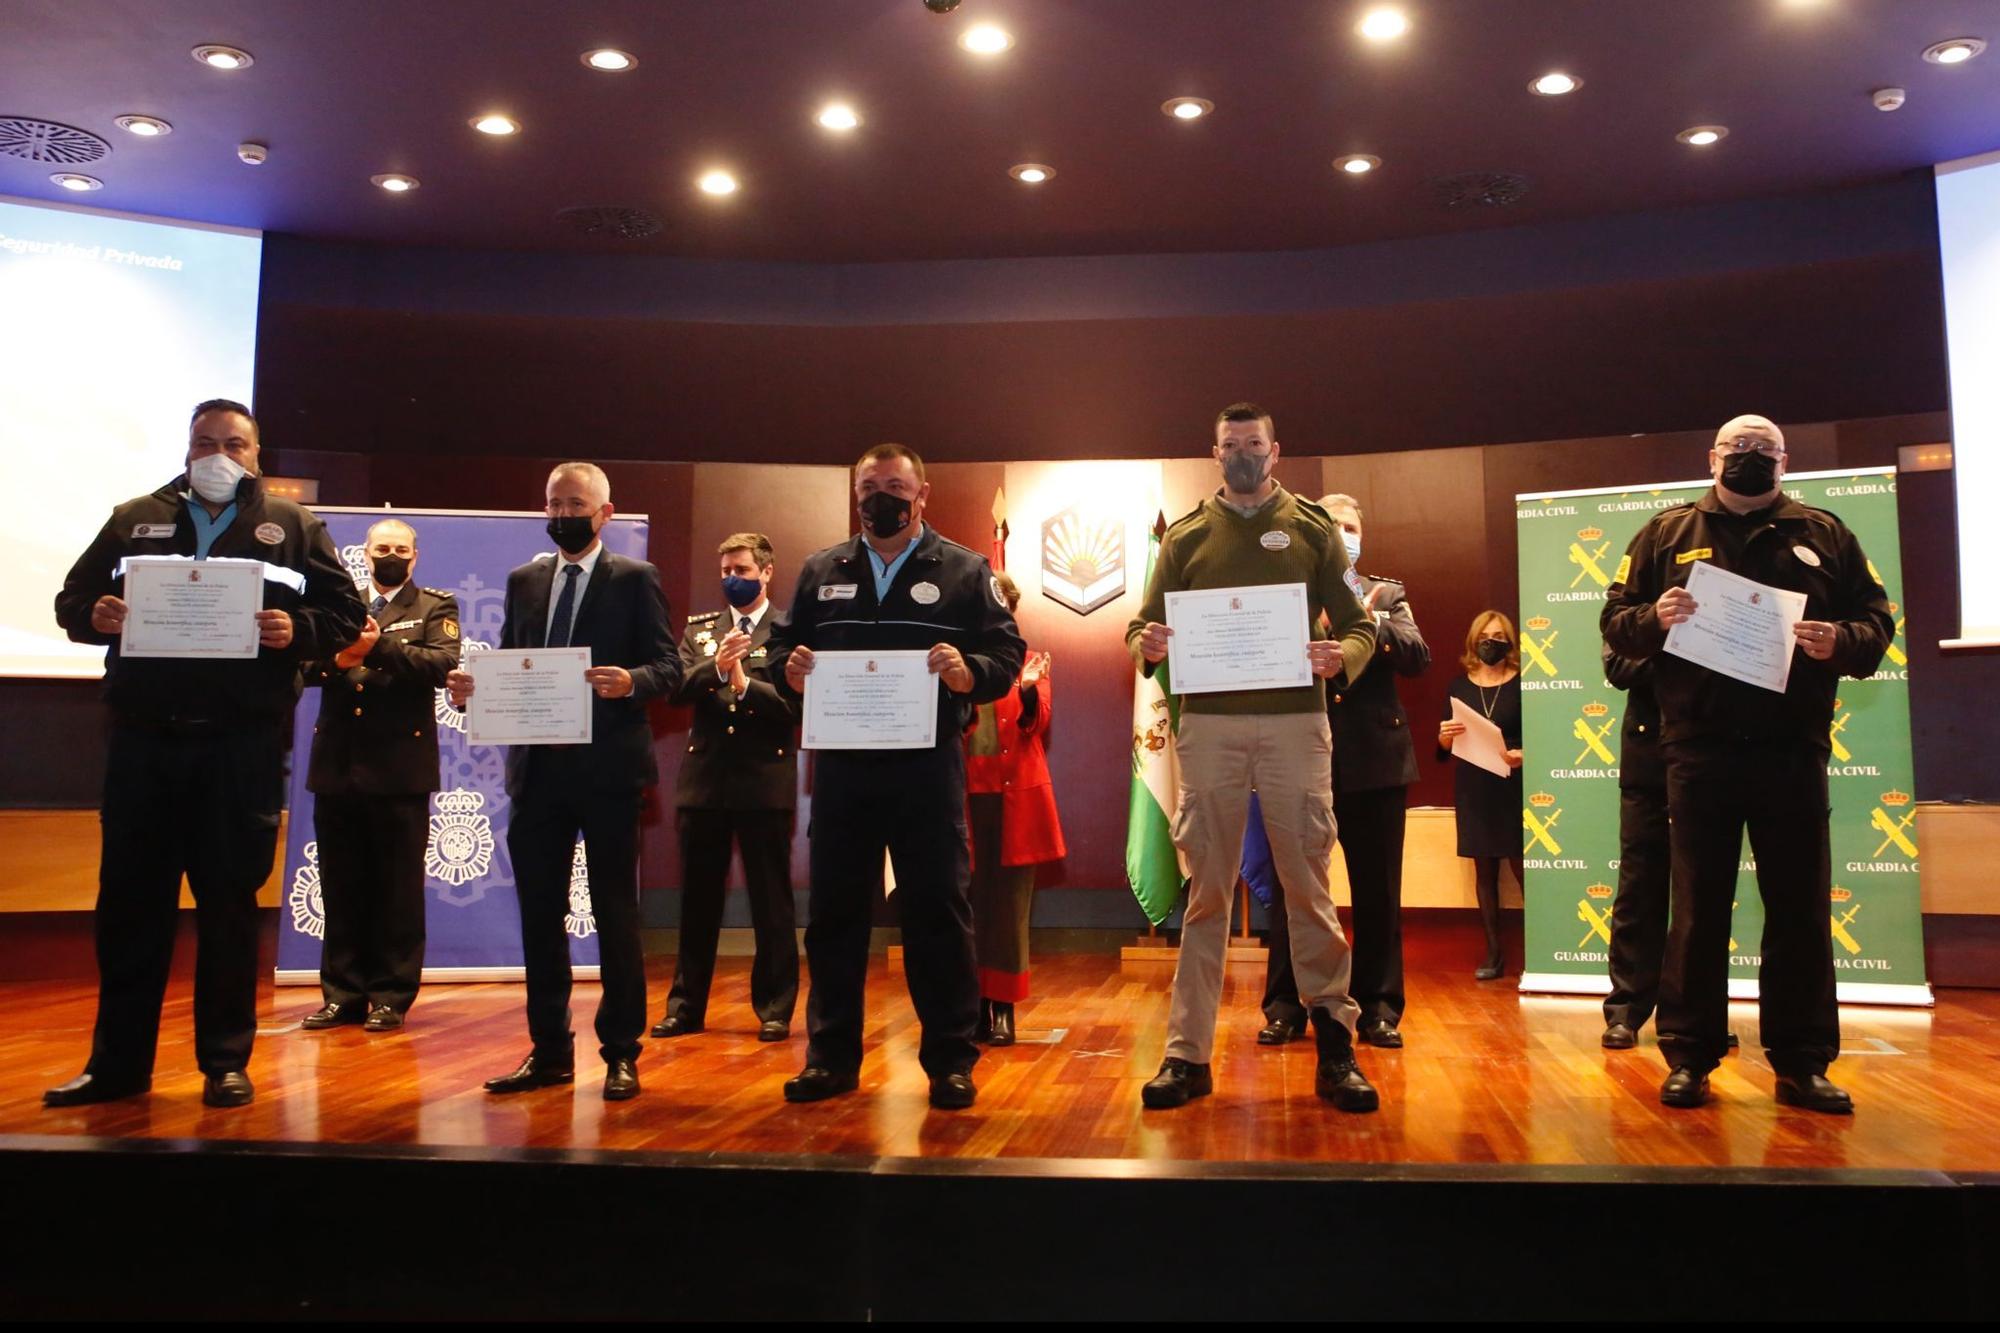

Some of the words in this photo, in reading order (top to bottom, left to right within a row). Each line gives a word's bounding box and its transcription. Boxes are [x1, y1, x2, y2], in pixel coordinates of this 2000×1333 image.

[104, 247, 183, 271] Privada
[1826, 484, 1886, 497] GUARDIA
[1598, 500, 1653, 513] GUARDIA
[1517, 508, 1545, 519] RDIA
[1546, 506, 1578, 517] CIVIL
[1547, 592, 1601, 602] GUARDIA
[1520, 681, 1548, 691] RDIA
[1550, 680, 1583, 690] CIVIL
[1551, 769, 1606, 779] GUARDIA
[1842, 766, 1881, 776] CIVIL
[1523, 859, 1552, 869] RDIA
[1553, 859, 1588, 869] CIVIL
[1846, 862, 1909, 872] GUARDIA
[1554, 951, 1610, 962] GUARDIA
[1852, 958, 1892, 970] CIVIL
